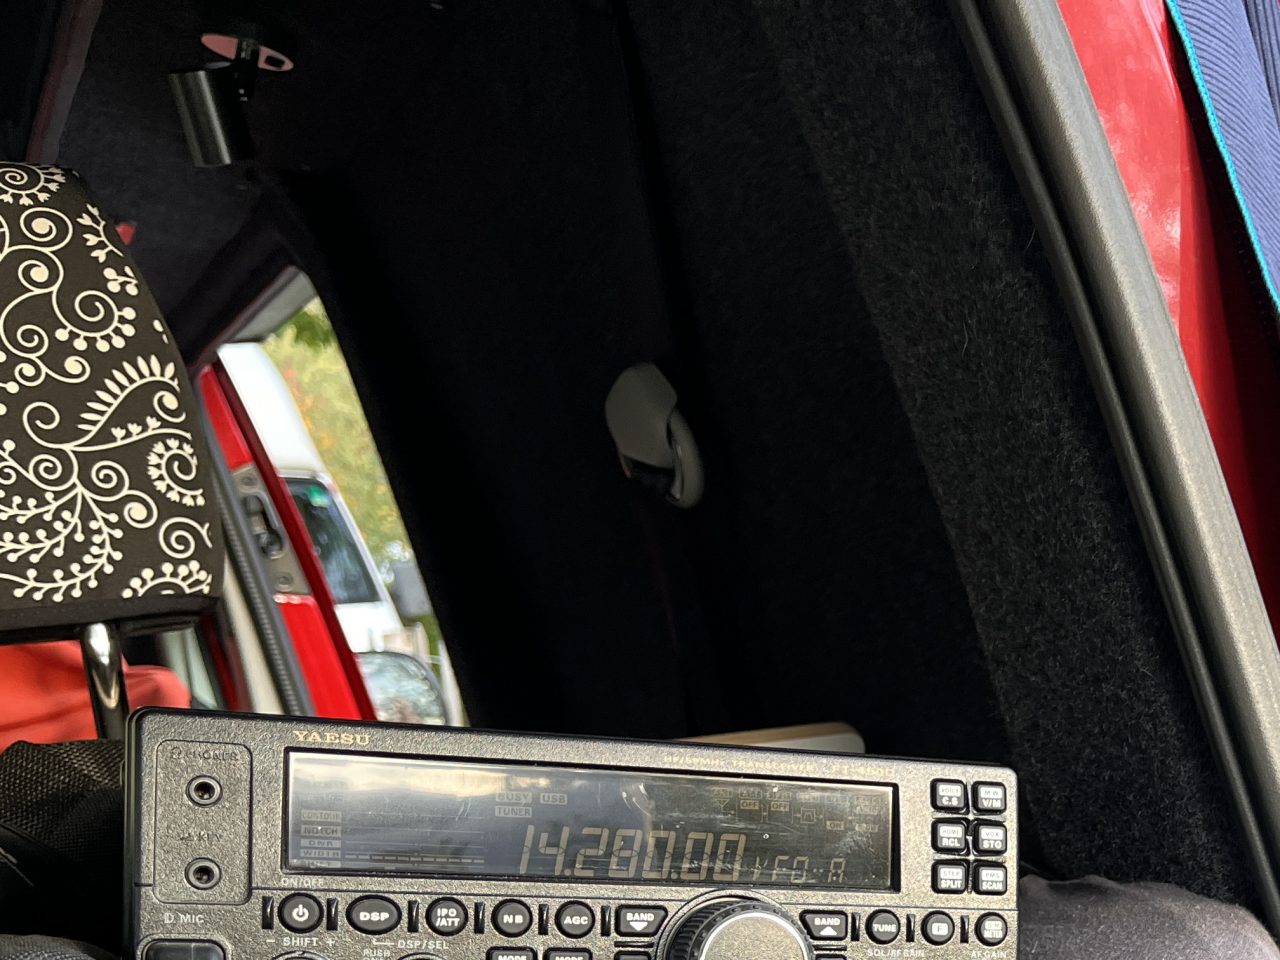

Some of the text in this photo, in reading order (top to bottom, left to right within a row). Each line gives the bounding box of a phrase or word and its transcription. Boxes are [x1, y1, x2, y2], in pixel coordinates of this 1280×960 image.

[293, 731, 371, 746] YAESU
[542, 794, 567, 804] USB
[941, 796, 959, 806] C.S
[982, 799, 1001, 808] V/M
[740, 800, 760, 809] OFF
[772, 802, 790, 811] OFF
[497, 806, 532, 817] TUNER
[302, 826, 339, 836] NOTCH
[941, 837, 961, 847] RCL
[982, 840, 1003, 849] STO
[302, 850, 340, 858] WIDTH
[281, 877, 325, 888] ON/OFF
[940, 880, 962, 889] SPLIT
[981, 881, 1003, 890] SCAN
[359, 911, 390, 921] DSP
[436, 907, 457, 917] IPO
[625, 912, 655, 922] BAND
[180, 913, 205, 924] MIC
[435, 917, 460, 927] /ATT
[563, 915, 589, 925] AGC
[813, 916, 841, 926] BAND
[872, 923, 897, 933] TUNE
[282, 936, 319, 947] SHIFT
[397, 939, 449, 950] DSP/SEL
[363, 948, 391, 958] PUSH
[866, 948, 925, 959] SQL/RF GAIN
[971, 950, 1007, 960] AF GAIN
